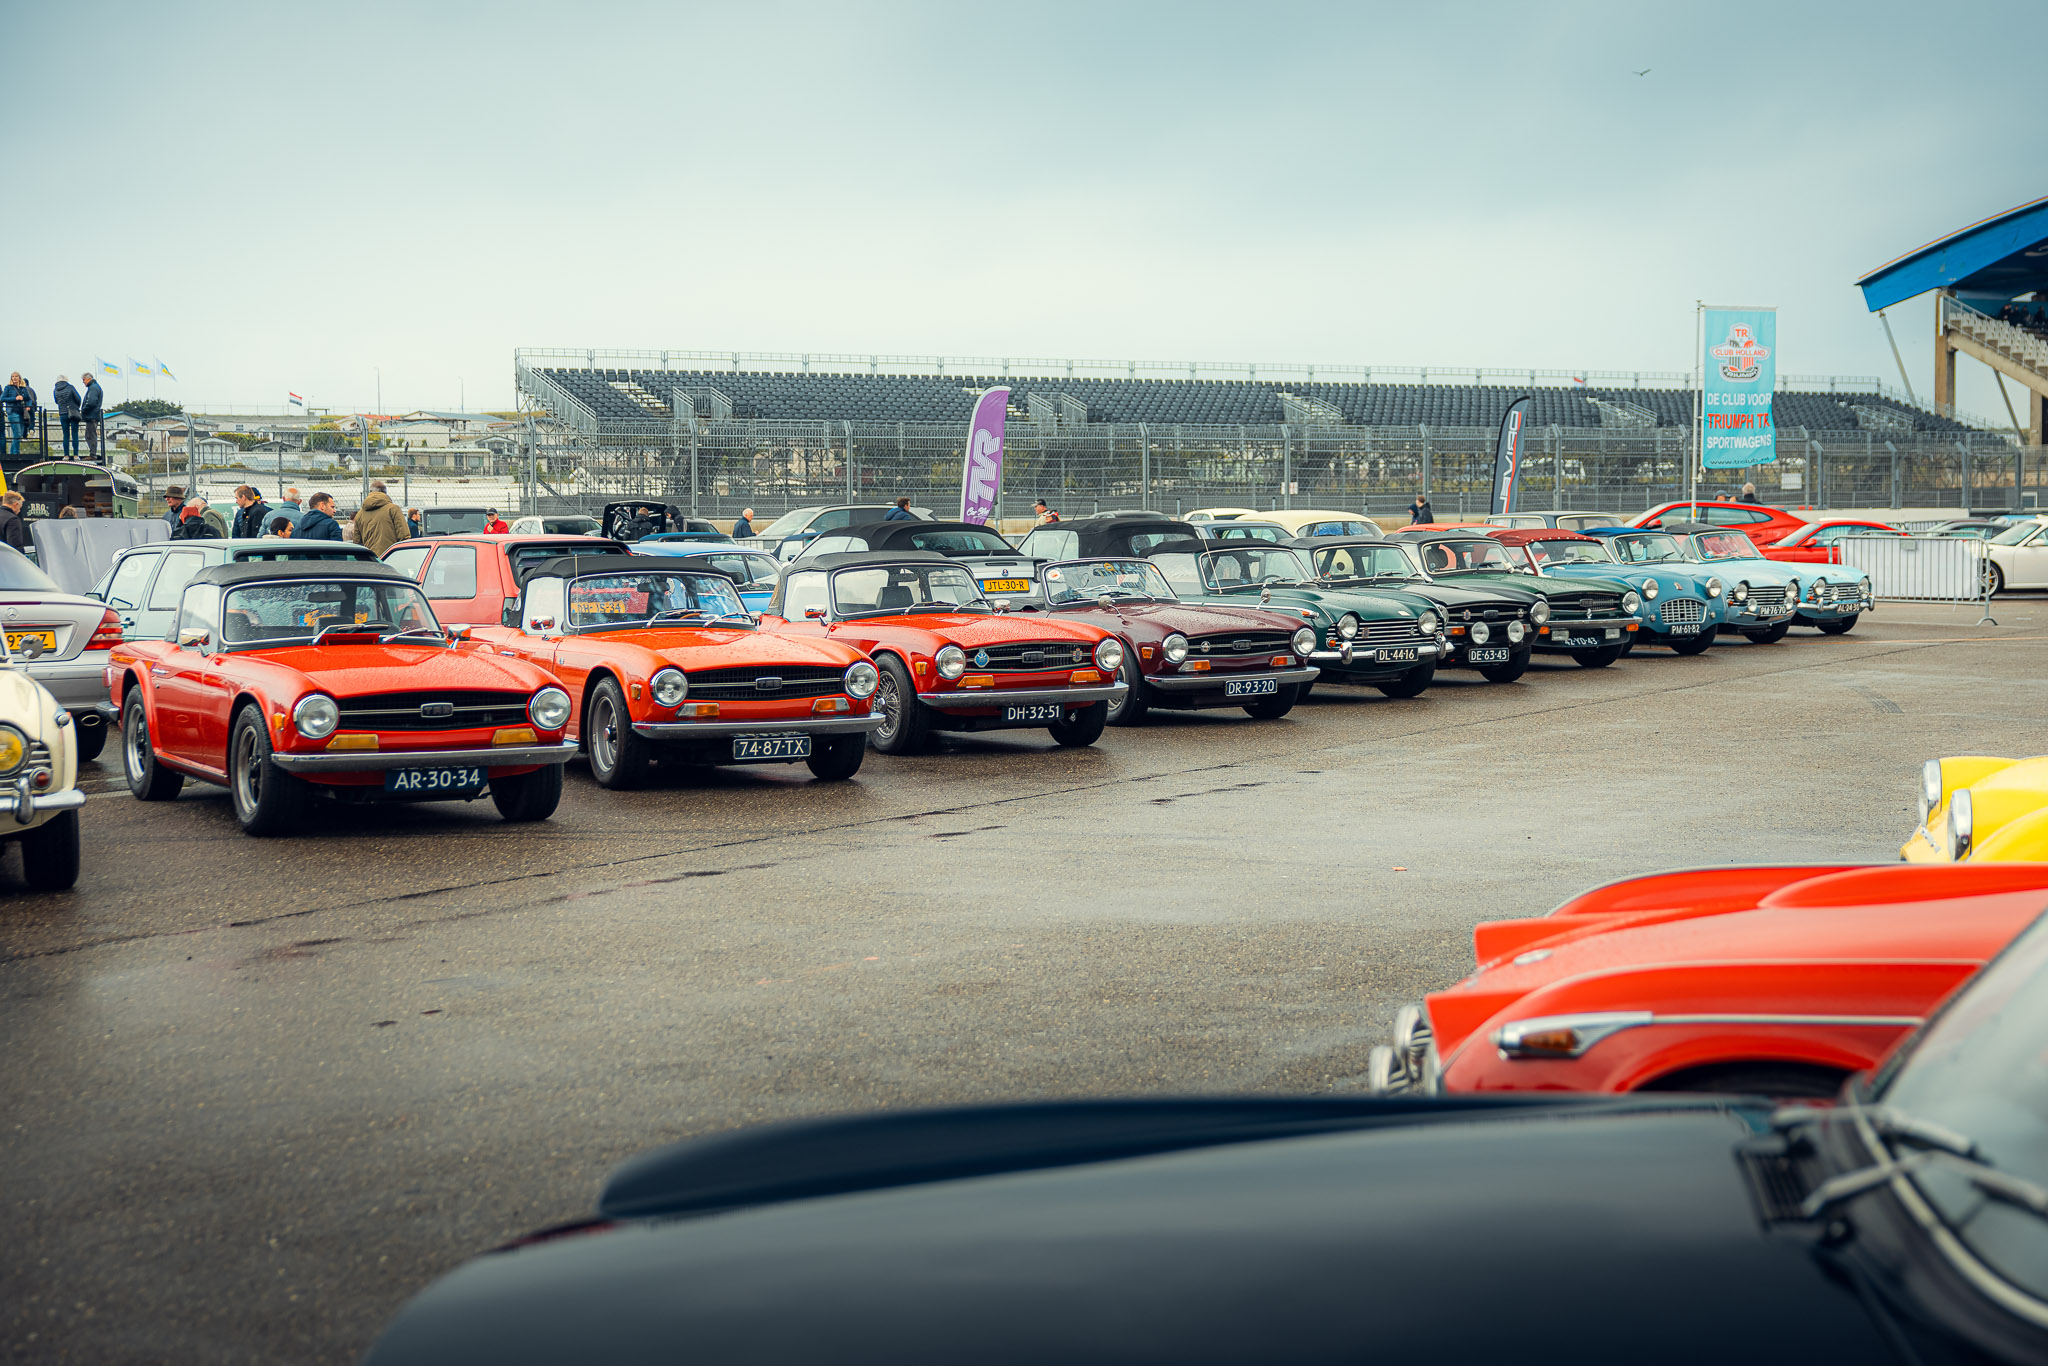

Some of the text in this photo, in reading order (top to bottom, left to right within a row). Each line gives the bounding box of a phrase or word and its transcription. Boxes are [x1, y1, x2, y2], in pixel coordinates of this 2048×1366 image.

[1735, 328, 1748, 338] TR
[1735, 349, 1766, 357] HOLLAND
[1707, 393, 1772, 406] DE CLUB VOOR
[1707, 413, 1754, 429] TRIUMPH
[1707, 434, 1772, 449] SPORTWAGENS
[969, 429, 1000, 504] TVR
[988, 580, 1025, 590] JTL-30-R
[1760, 606, 1786, 615] PM-76-70
[1671, 624, 1700, 635] PM-61-82
[1380, 649, 1414, 660] DL-44-16
[1471, 650, 1507, 660] DE-63-43
[1228, 680, 1275, 694] DR-93-20
[1008, 705, 1060, 720] DH-32-51
[739, 740, 804, 756] 74-87-TX
[394, 769, 480, 789] AR-30-34
